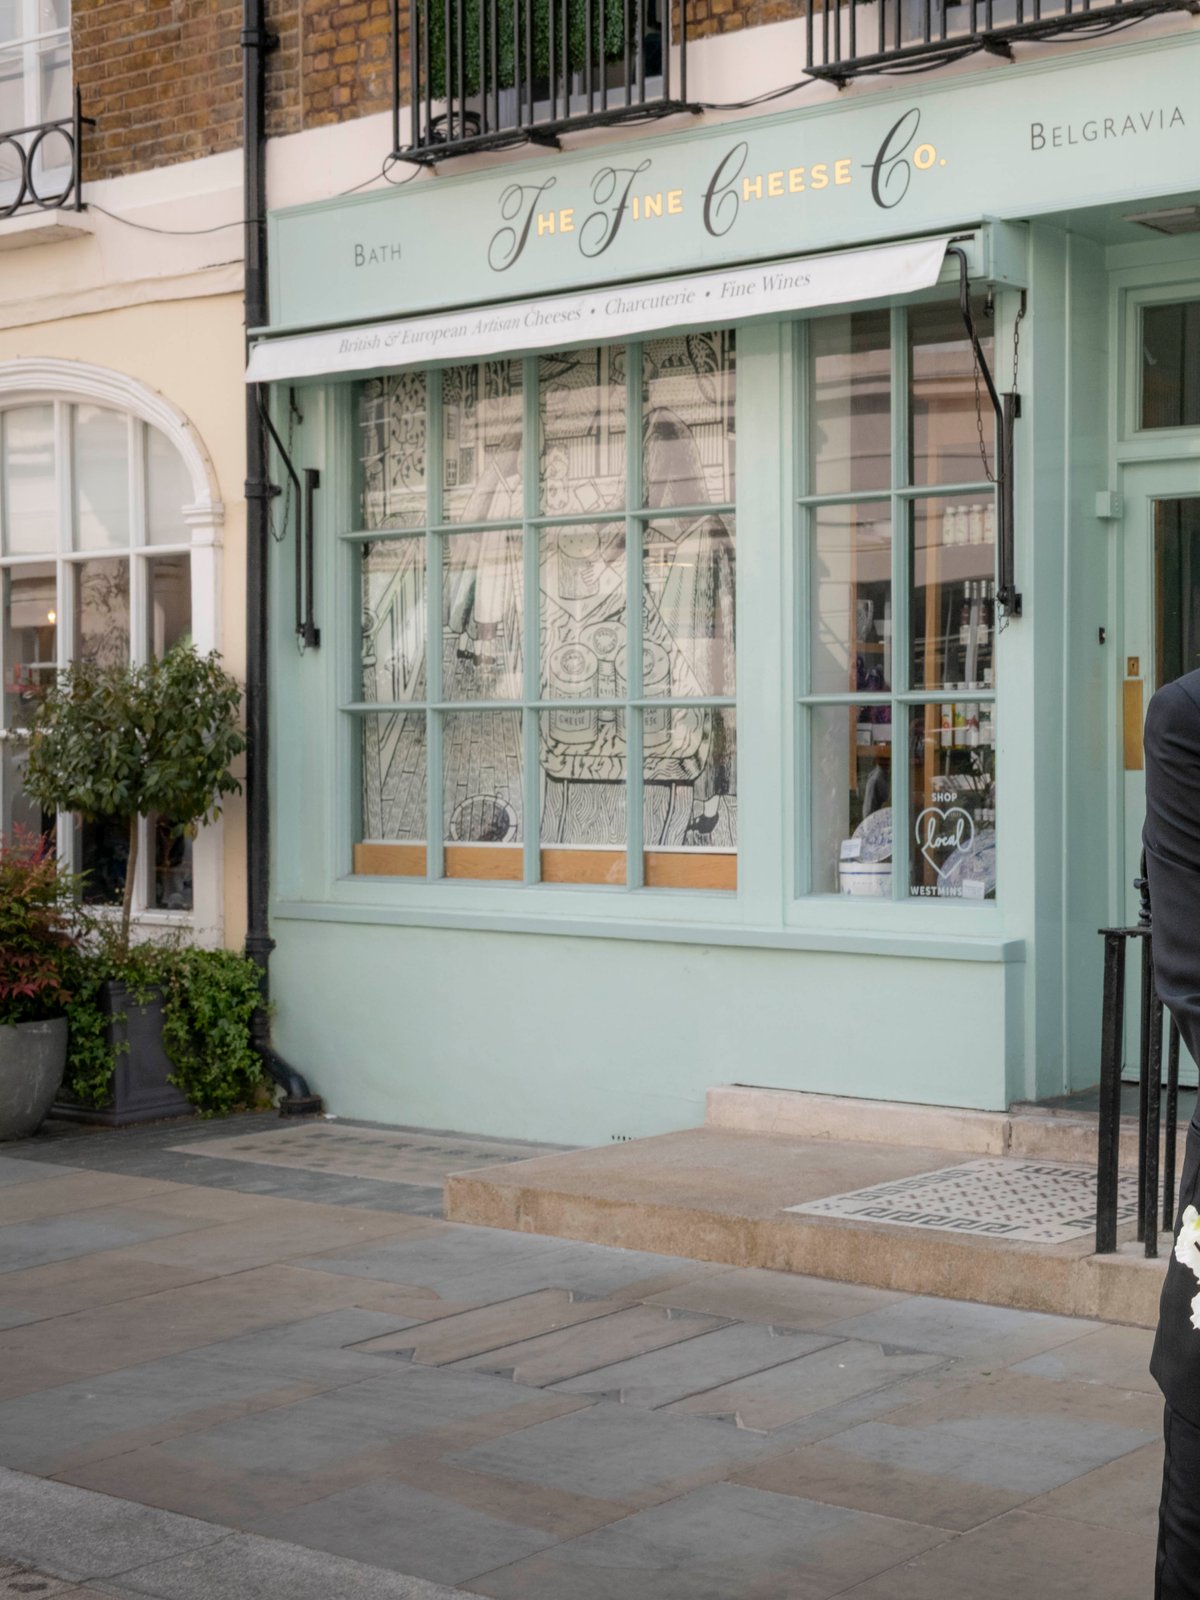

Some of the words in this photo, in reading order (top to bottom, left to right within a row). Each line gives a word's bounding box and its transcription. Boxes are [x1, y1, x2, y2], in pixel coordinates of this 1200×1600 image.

[1030, 106, 1186, 151] BELGRAVIA
[578, 158, 685, 258] FINE
[701, 141, 853, 237] CHEESE
[354, 242, 402, 267] BATH
[338, 335, 381, 354] British
[384, 331, 401, 347] &
[401, 324, 467, 347] European
[472, 317, 521, 336] Artisan
[523, 307, 581, 329] Cheeses
[604, 286, 696, 317] Charcuterie
[720, 279, 756, 299] Fine
[761, 272, 811, 293] Wines
[931, 792, 958, 802] SHOP
[926, 817, 965, 850] local
[910, 885, 963, 896] WESTMINS
